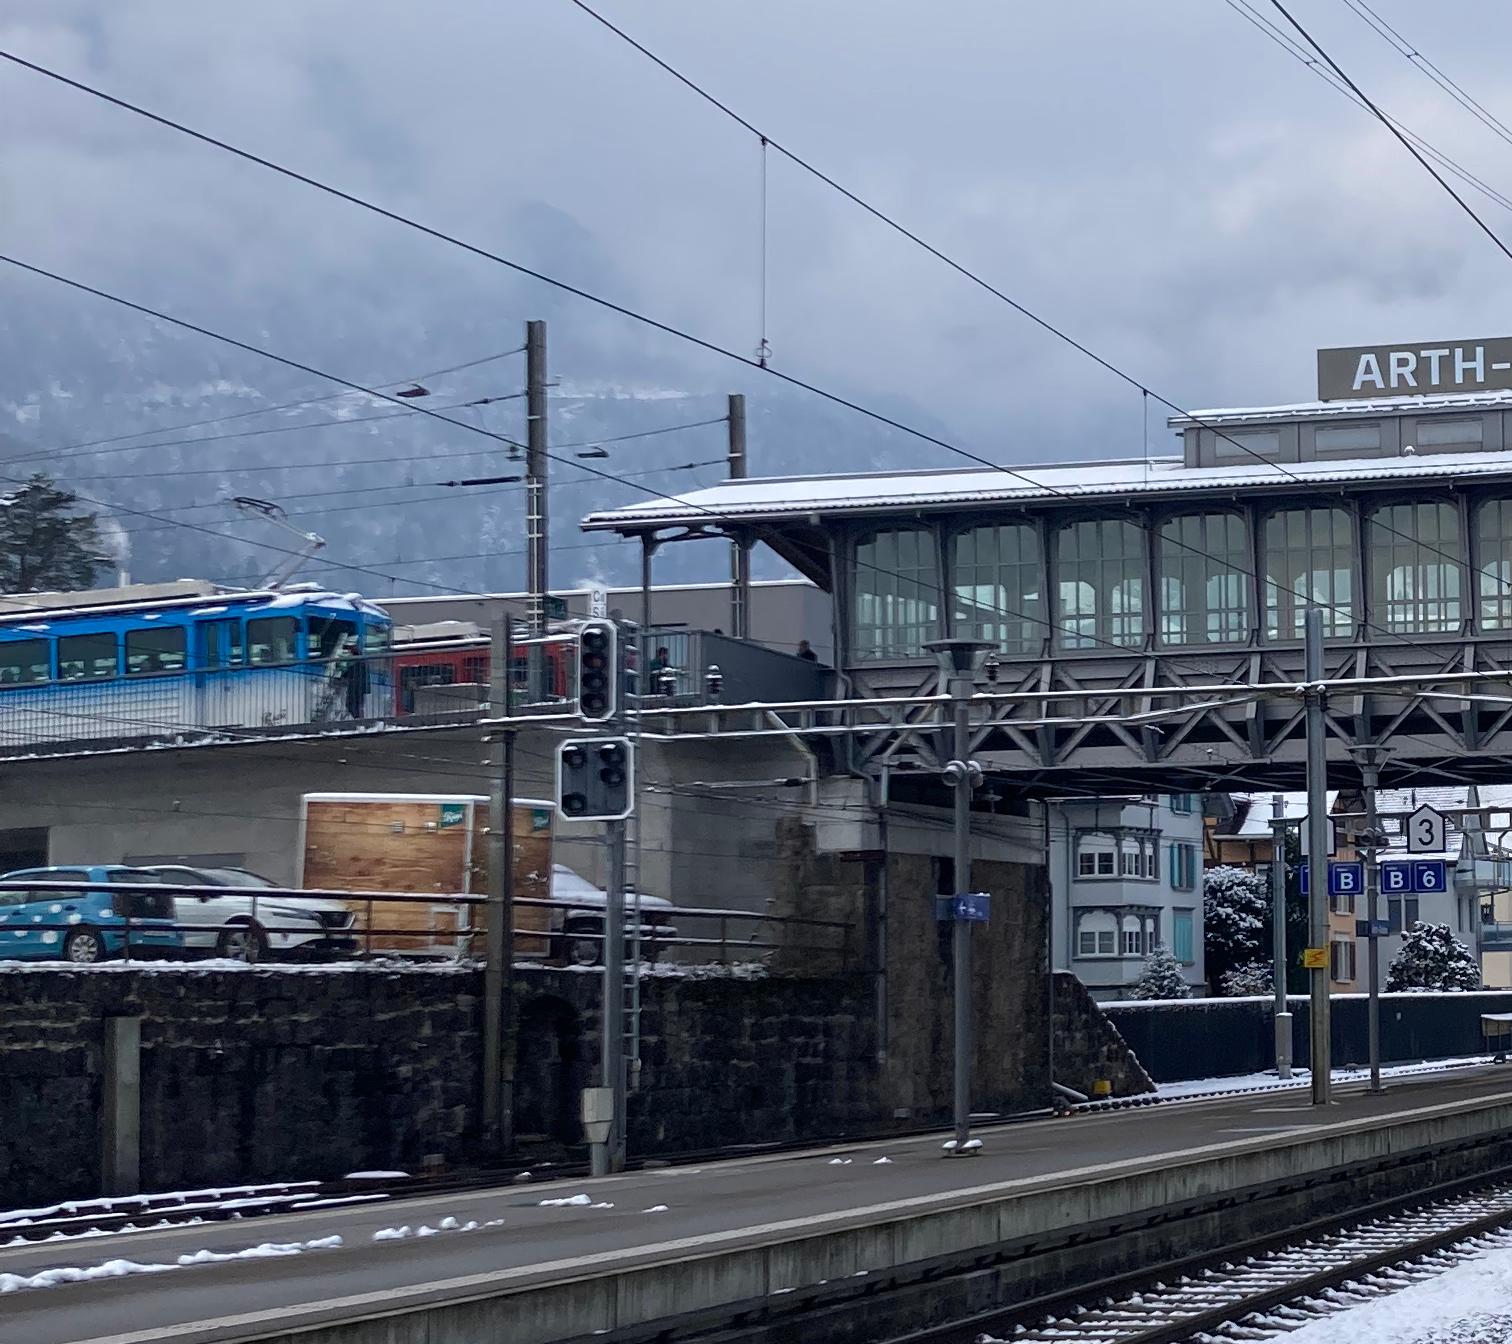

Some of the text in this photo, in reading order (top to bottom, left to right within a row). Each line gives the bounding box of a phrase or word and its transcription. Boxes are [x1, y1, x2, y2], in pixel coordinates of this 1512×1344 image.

[1419, 819, 1434, 846] 3
[1341, 873, 1354, 890] B
[1391, 871, 1436, 889] B 6
